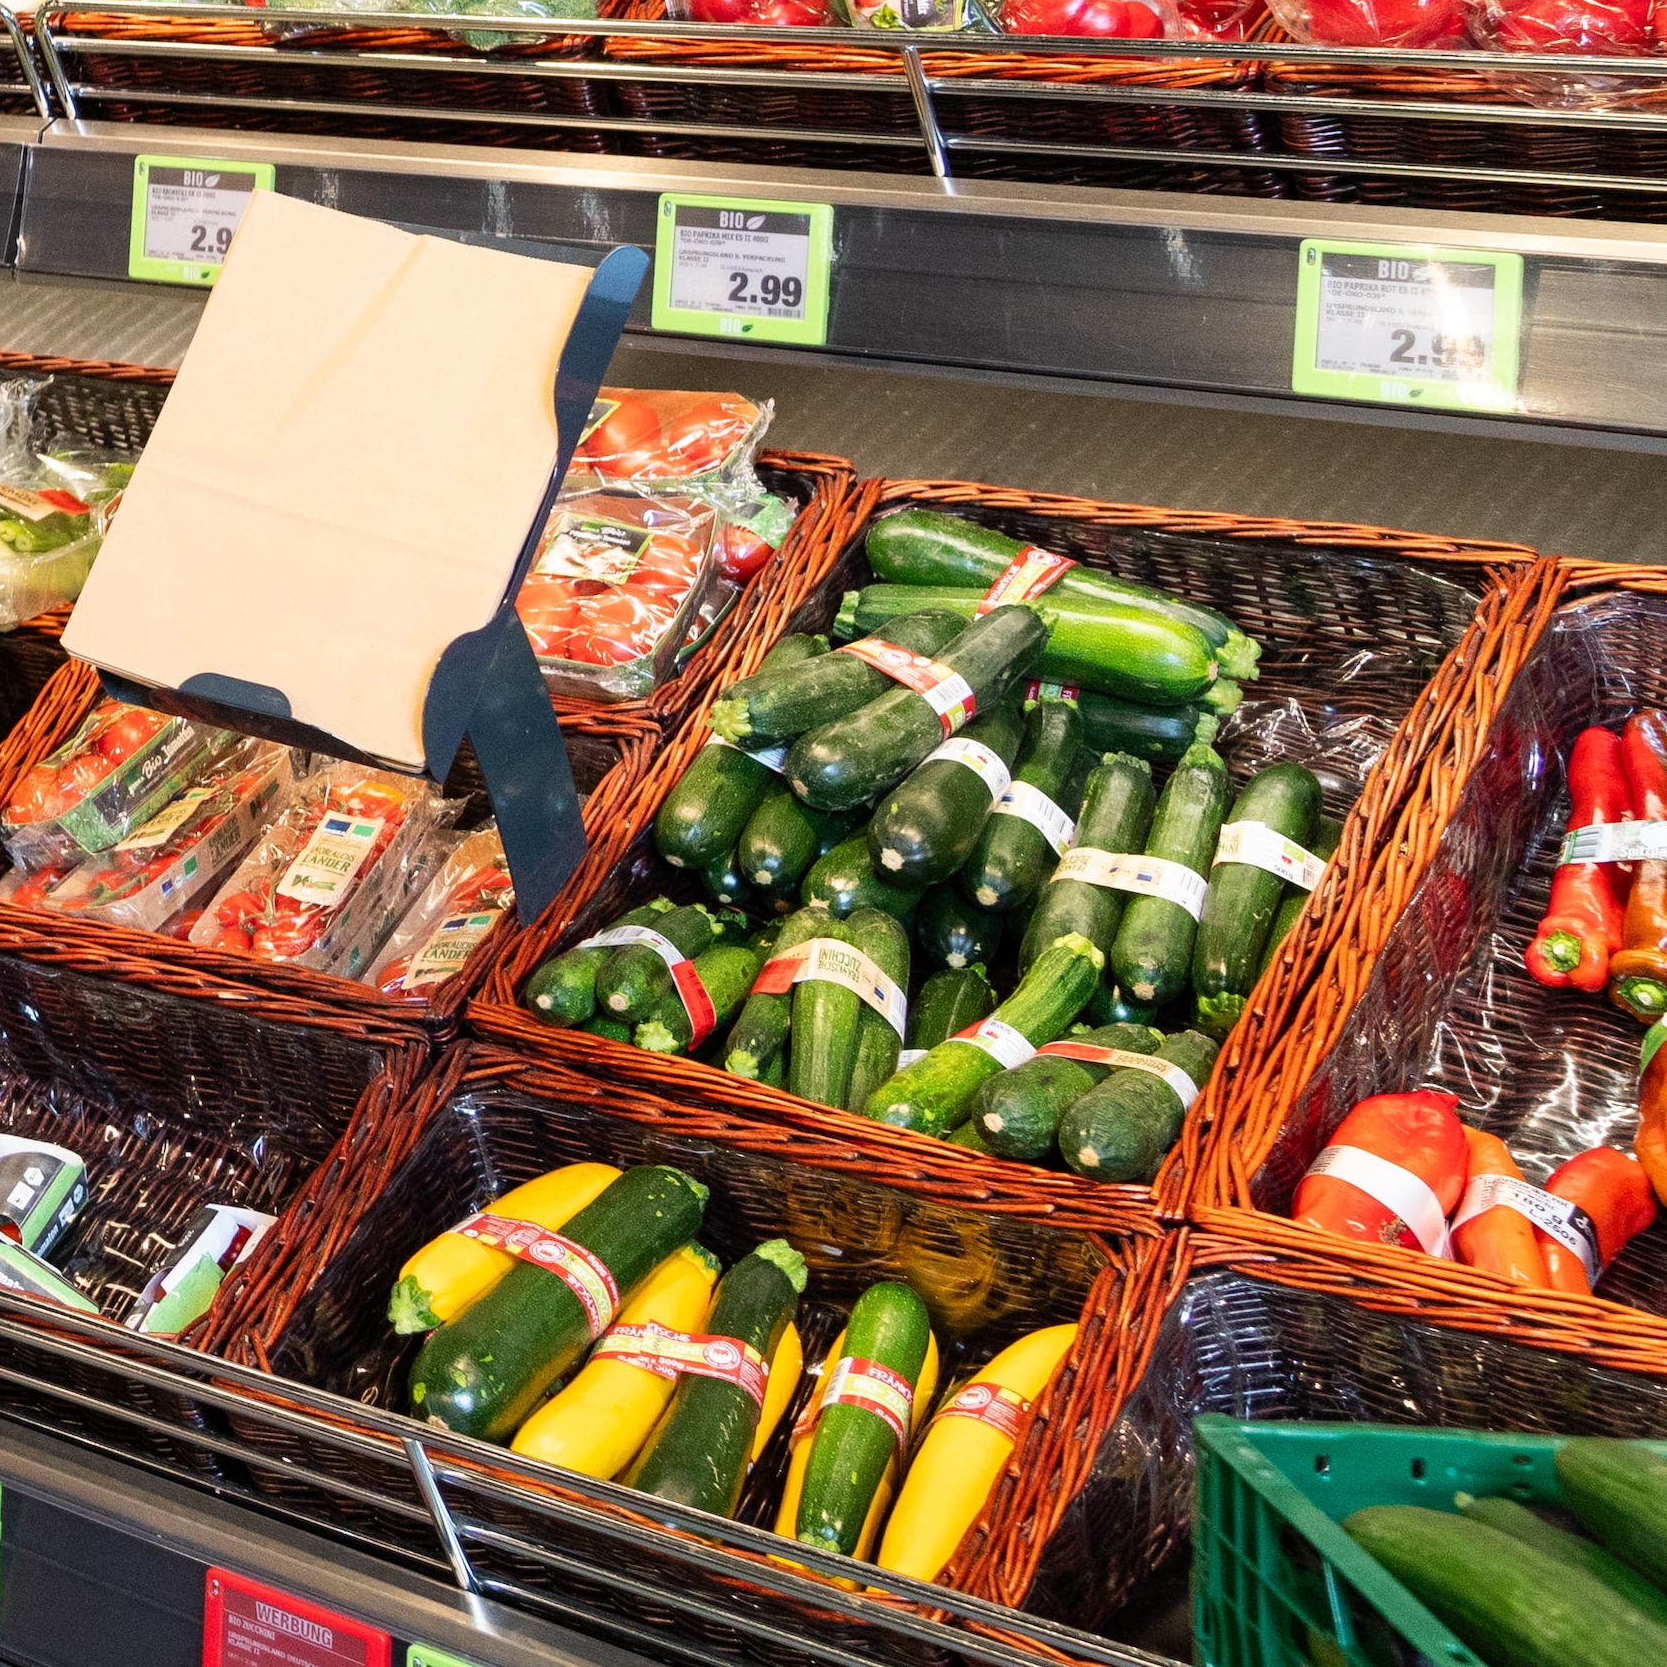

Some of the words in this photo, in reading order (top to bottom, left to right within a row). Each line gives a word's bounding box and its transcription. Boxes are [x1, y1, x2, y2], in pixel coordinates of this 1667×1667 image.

[182, 169, 204, 187] BIO
[719, 210, 744, 229] BIO
[189, 223, 236, 255] 2.9
[679, 229, 692, 237] BIO
[692, 230, 720, 240] PAPRIKA
[721, 232, 734, 241] MIX
[735, 233, 743, 241] ES
[744, 234, 751, 242] II
[183, 265, 200, 280] BIO
[1377, 259, 1409, 280] BIO
[727, 270, 803, 308] 2.99
[1326, 280, 1342, 289] BIO
[1343, 281, 1379, 292] PAPRIKA
[1380, 284, 1396, 293] ROT
[1398, 285, 1408, 294] ES
[1325, 308, 1355, 317] KLASSE
[719, 318, 741, 333] BIO
[1380, 380, 1408, 398] BIO
[142, 756, 163, 778] Bio
[160, 718, 195, 765] Tomaten
[1511, 1192, 1546, 1214] 180
[1551, 1214, 1564, 1227] g
[1528, 1208, 1578, 1247] L-2506
[228, 1614, 241, 1627] BIO
[242, 1619, 276, 1641] ZUCCHINI
[254, 1600, 333, 1649] WERBUNG
[227, 1629, 286, 1659] URSPRUNGSLAND
[227, 1636, 252, 1653] KLASSE
[252, 1646, 260, 1656] II
